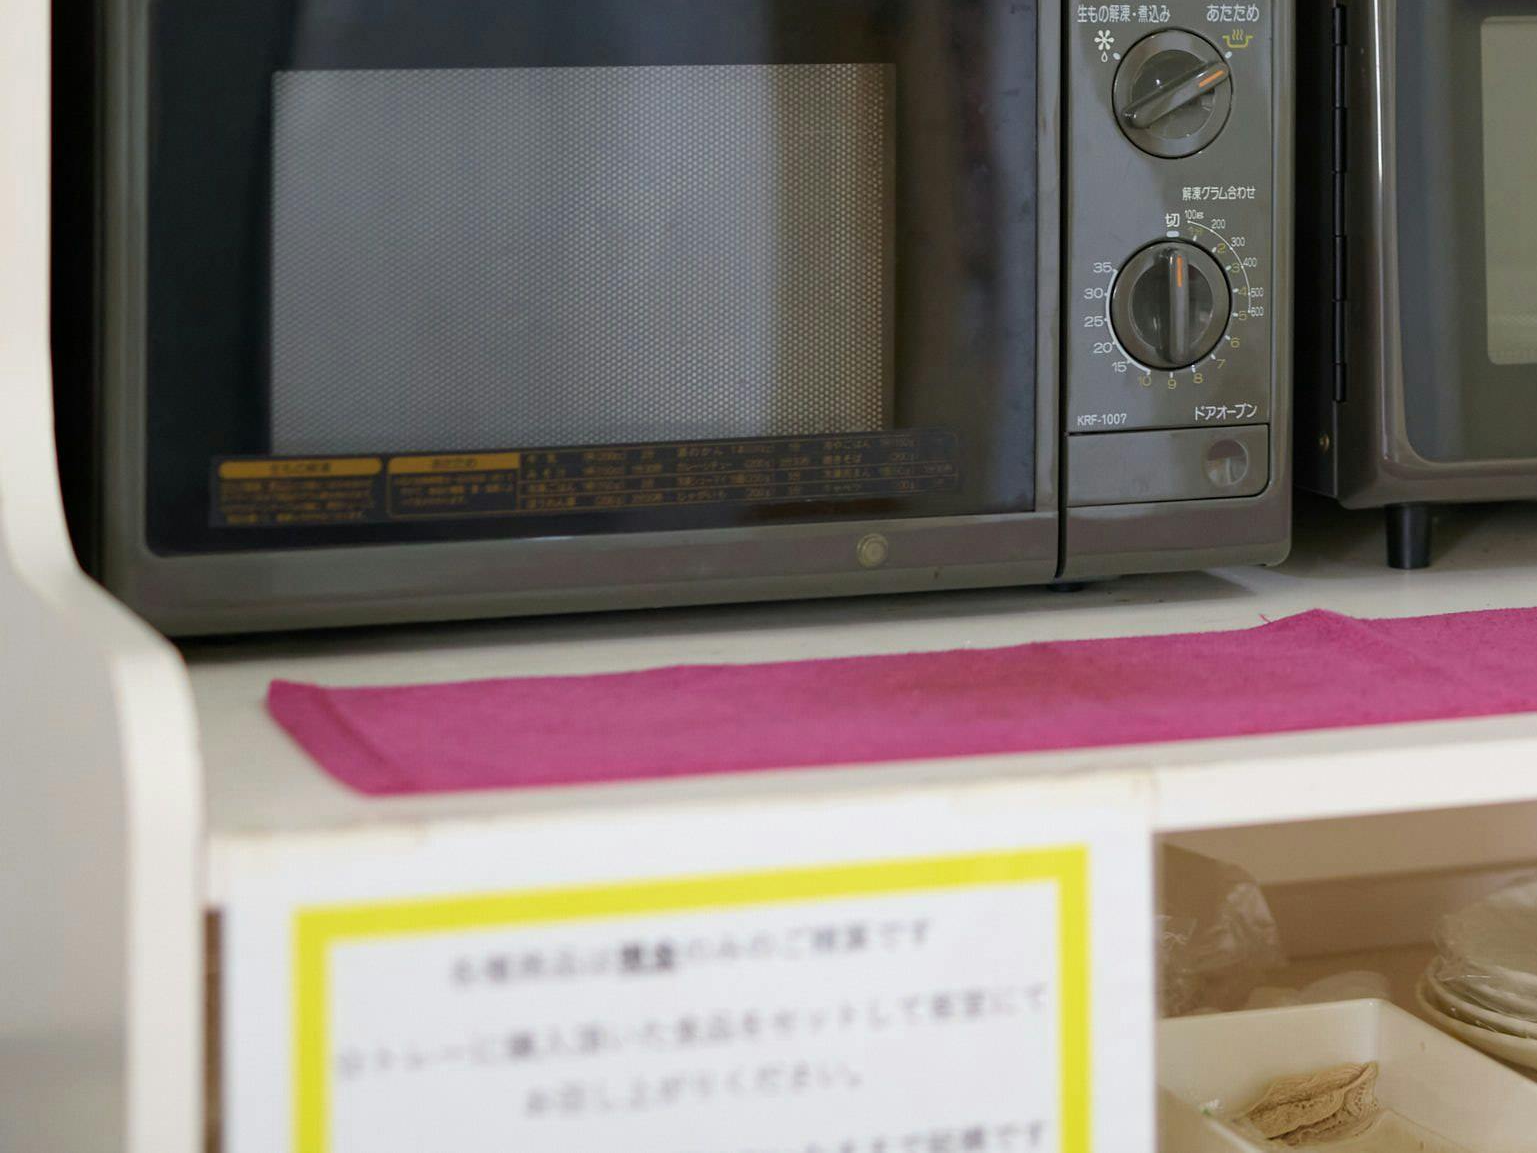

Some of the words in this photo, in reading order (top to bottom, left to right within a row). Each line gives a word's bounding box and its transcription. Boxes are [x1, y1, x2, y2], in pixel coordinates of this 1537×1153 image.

[1077, 4, 1171, 23] 生もの解凍・煮込み
[1206, 3, 1260, 23] あたため
[1182, 186, 1256, 201] 解凍グラム合わせ
[1165, 213, 1180, 228] 切
[1211, 219, 1226, 229] 200
[1217, 242, 1227, 254] 2
[1231, 236, 1246, 248] 300
[1093, 261, 1113, 274] 35
[1231, 263, 1241, 274] 3
[1243, 257, 1258, 268] 400
[1084, 288, 1104, 299] 30
[1238, 287, 1247, 296] 4
[1084, 315, 1104, 328] 25
[1238, 310, 1248, 321] 5
[1093, 342, 1113, 354] 20
[1230, 337, 1240, 348] 6
[1112, 361, 1127, 373] 15
[1216, 359, 1226, 369] 7
[1139, 376, 1152, 387] 10
[1167, 378, 1177, 390] 9
[1193, 372, 1204, 385] 8
[1194, 403, 1257, 421] ドアオープン
[1077, 413, 1127, 426] KRF-1007
